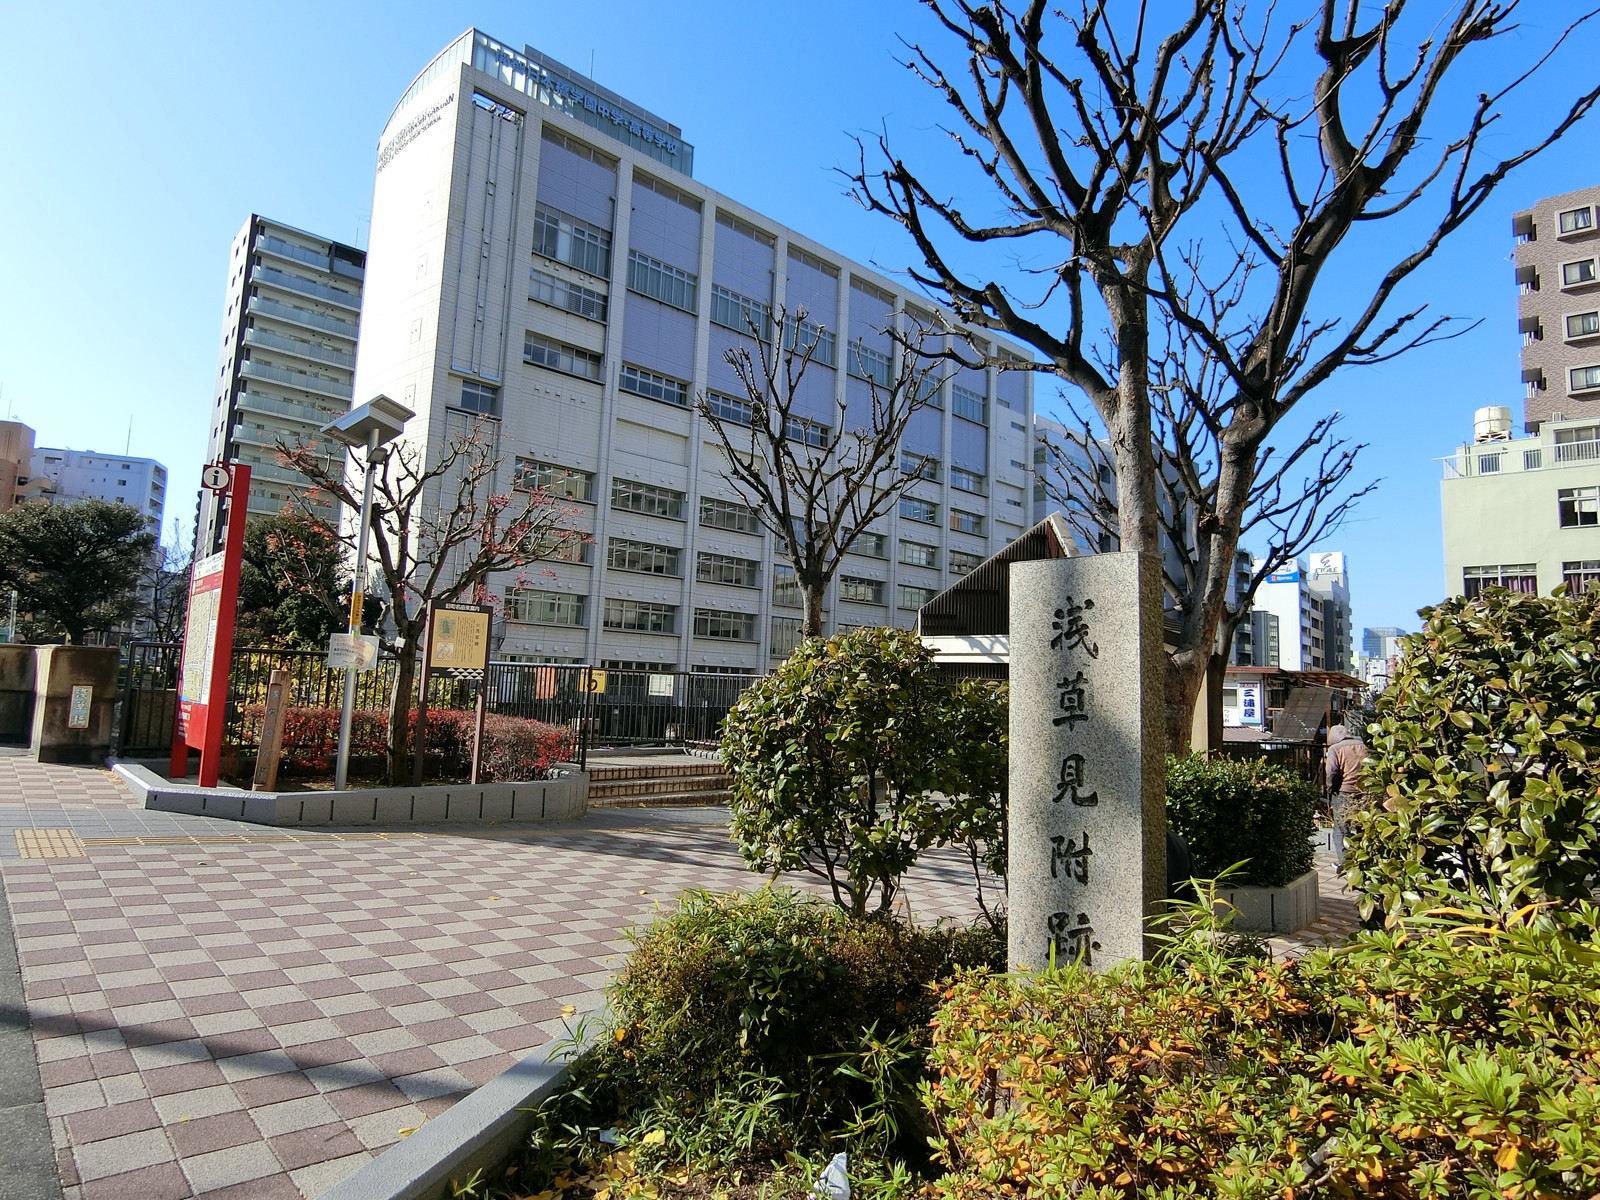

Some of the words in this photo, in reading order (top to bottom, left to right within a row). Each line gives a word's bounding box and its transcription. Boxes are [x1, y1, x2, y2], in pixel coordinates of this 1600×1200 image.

[1046, 595, 1102, 967] 浅草見附跡
[1243, 688, 1256, 718] 三浦屋
